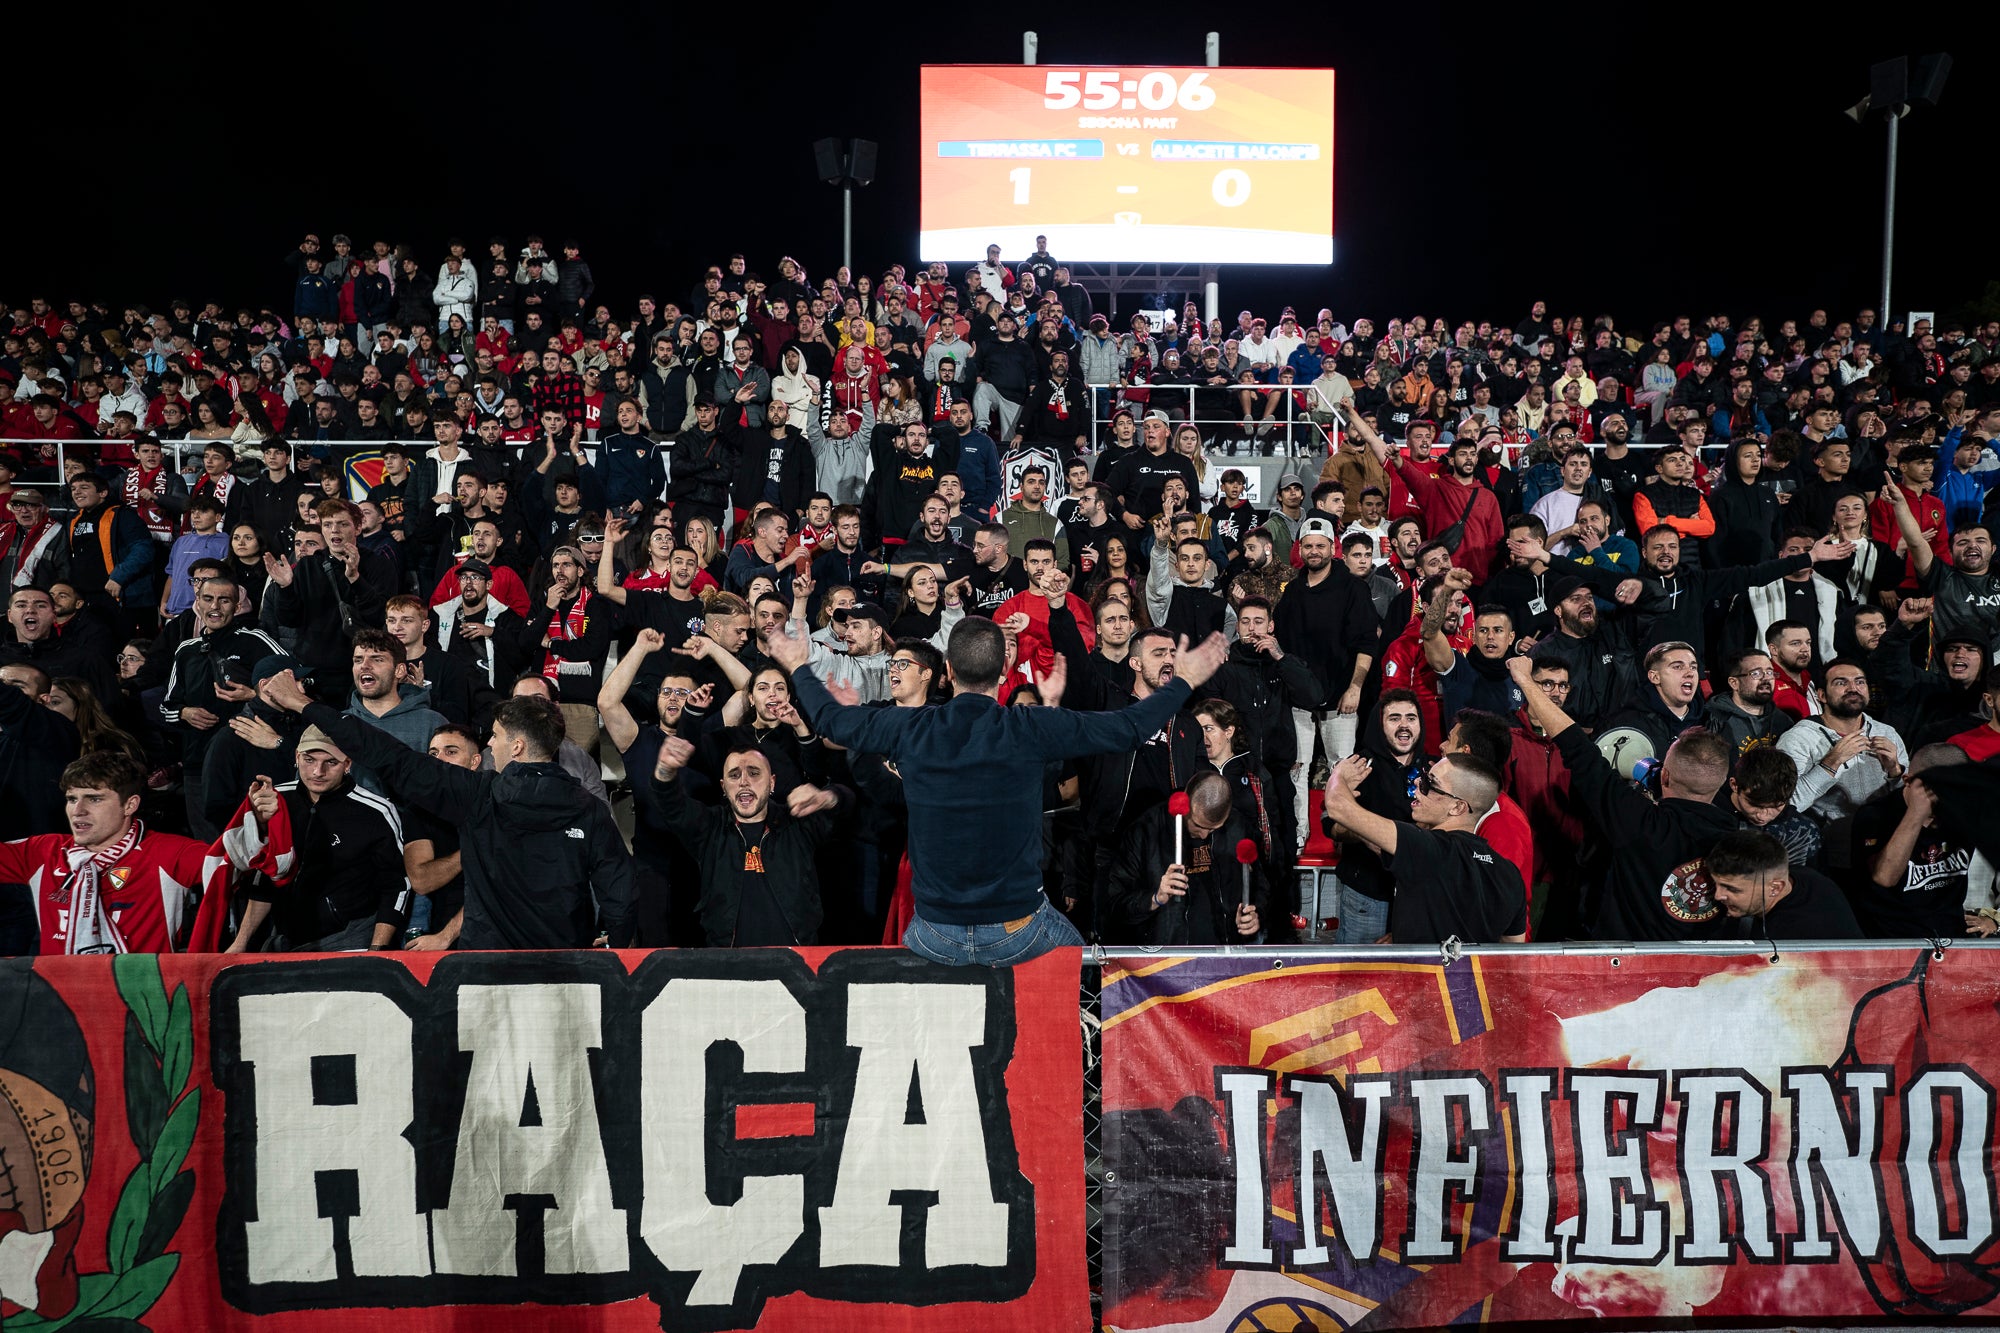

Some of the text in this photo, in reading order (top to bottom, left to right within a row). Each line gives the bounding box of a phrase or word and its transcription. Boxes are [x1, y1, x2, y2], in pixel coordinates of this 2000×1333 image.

[1043, 72, 1216, 111] 55:06
[1143, 116, 1178, 129] PART
[967, 142, 1077, 157] TERRASSA FC
[1152, 144, 1235, 159] ALBACETE
[1009, 168, 1031, 204] 1
[1212, 168, 1252, 207] 0
[1666, 900, 1719, 920] EGARENSE
[33, 1108, 79, 1186] 1906
[238, 979, 1011, 1306] RAÇA
[1214, 1065, 2000, 1268] INFIERNO
